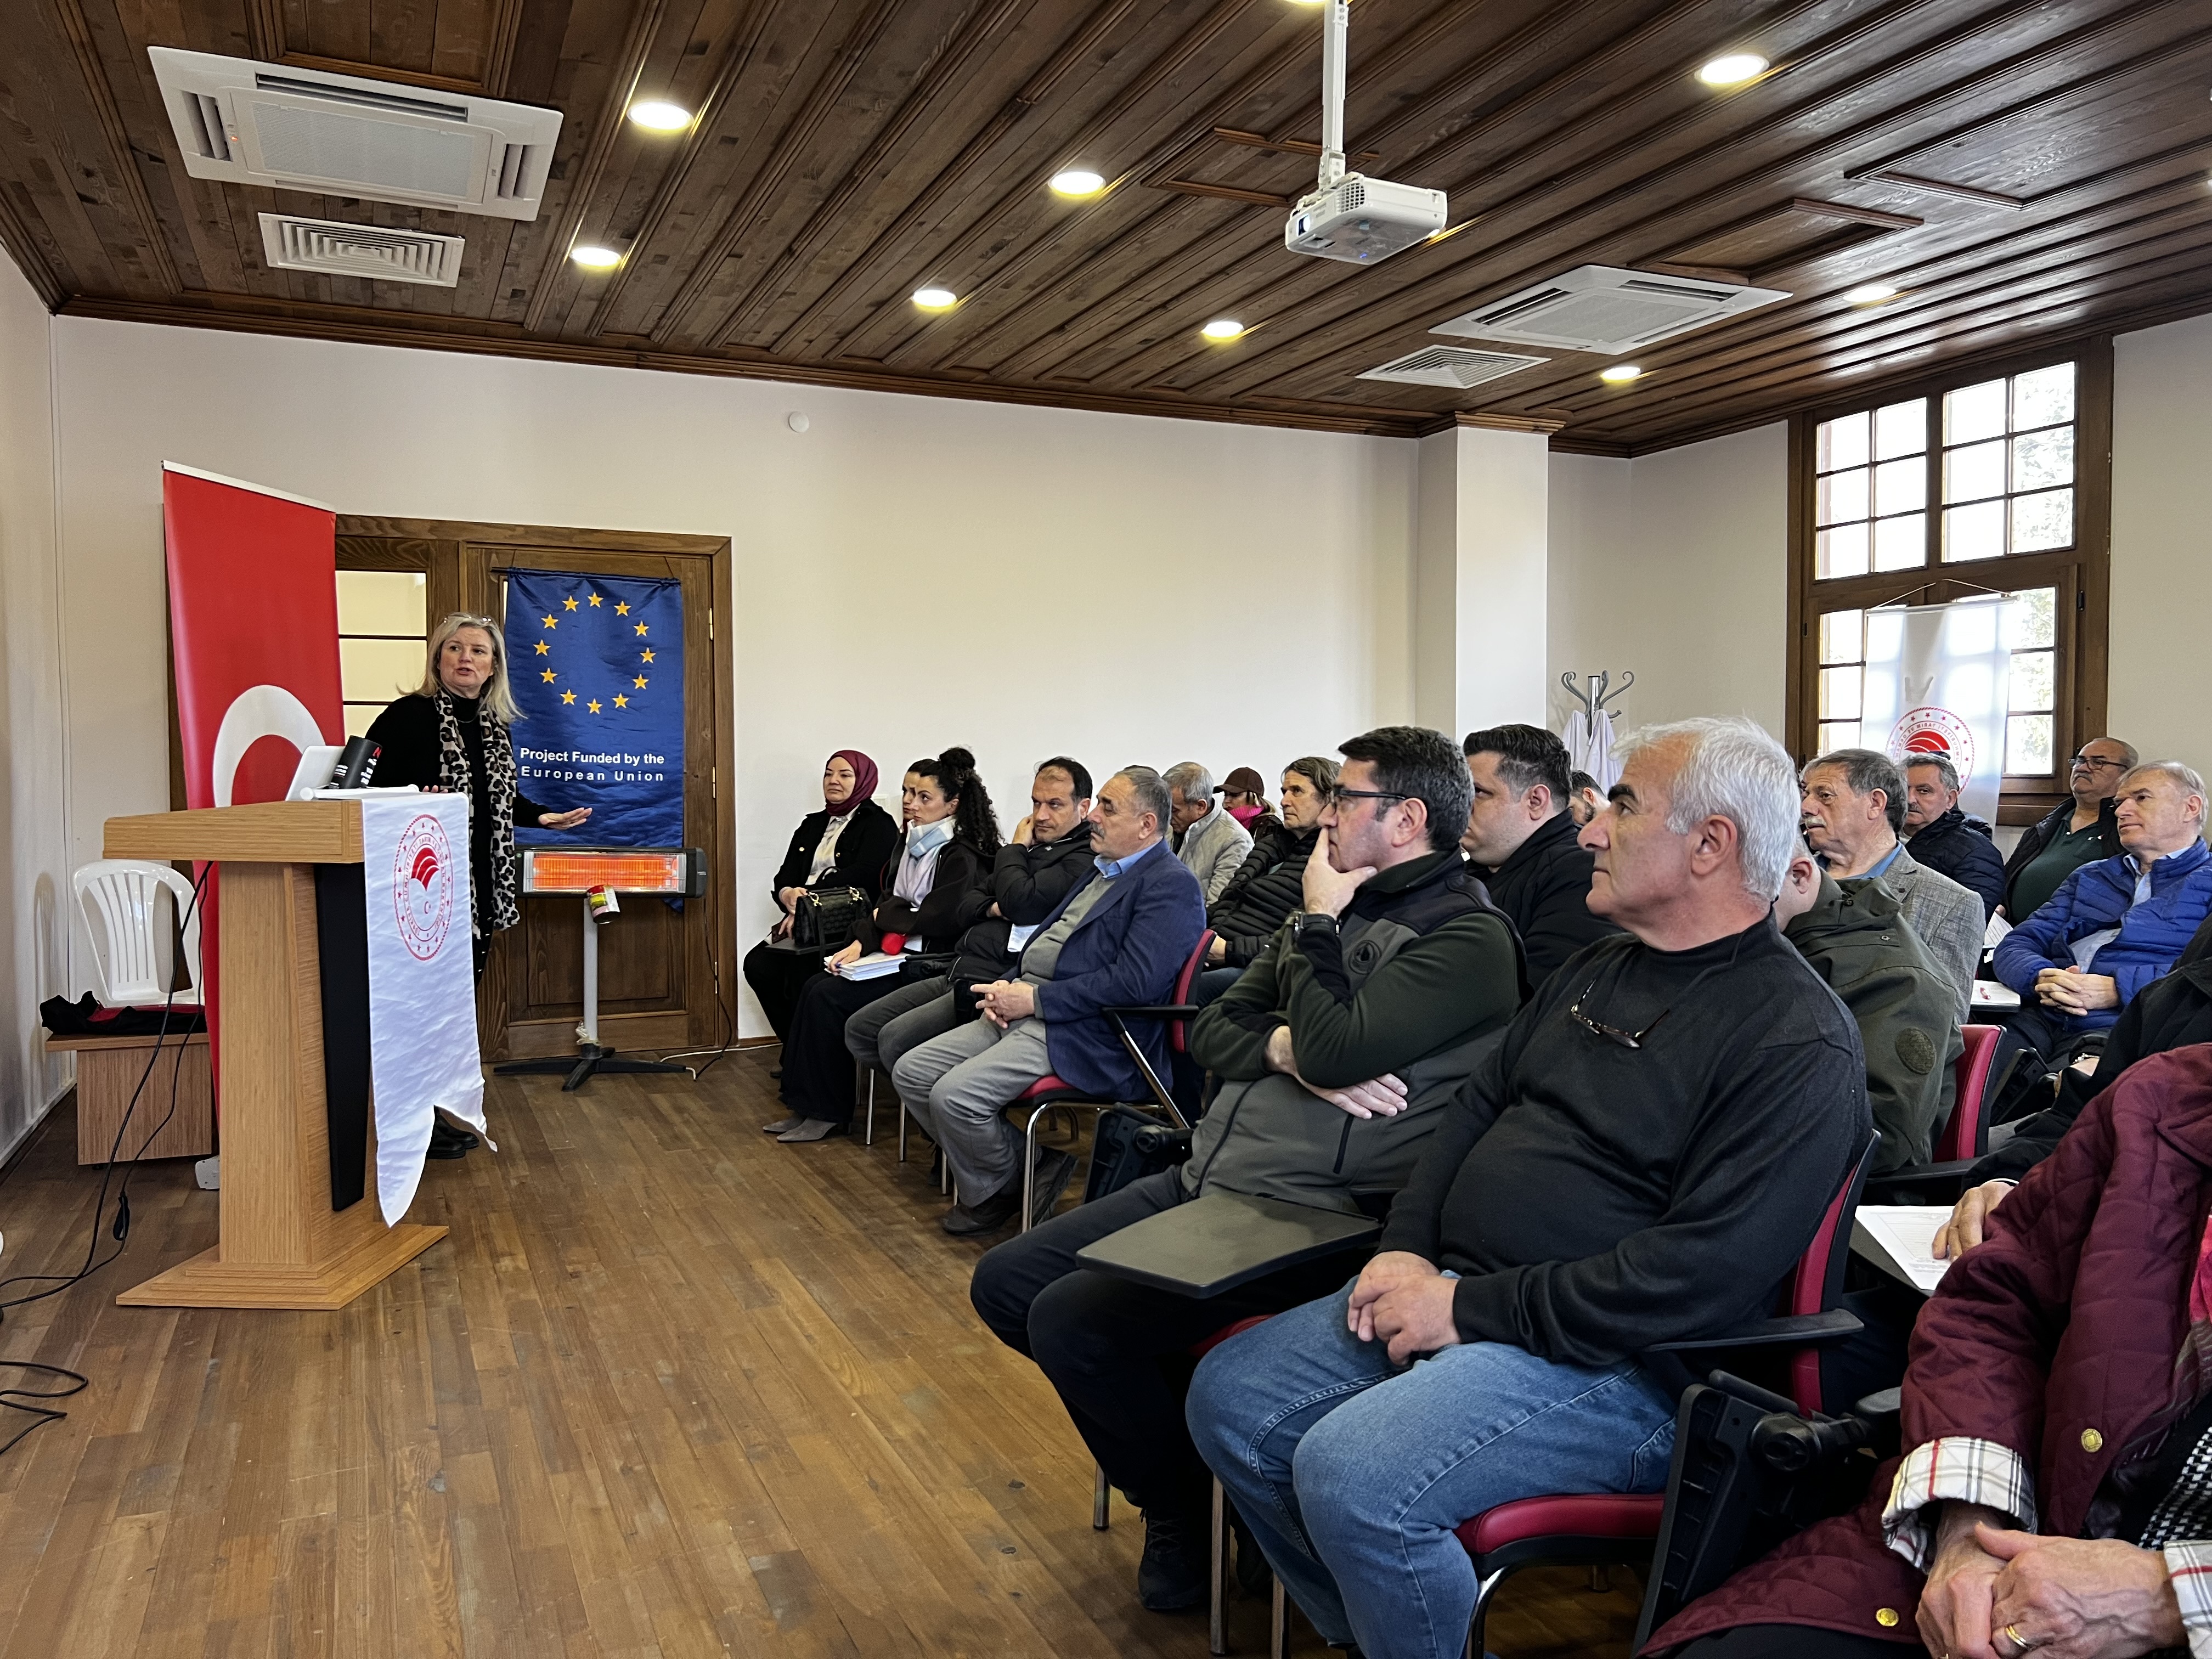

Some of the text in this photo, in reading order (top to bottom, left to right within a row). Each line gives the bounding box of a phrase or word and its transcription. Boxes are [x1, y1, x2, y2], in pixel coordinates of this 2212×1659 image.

[520, 747, 665, 766] Project Funded by the
[521, 766, 664, 781] European Union
